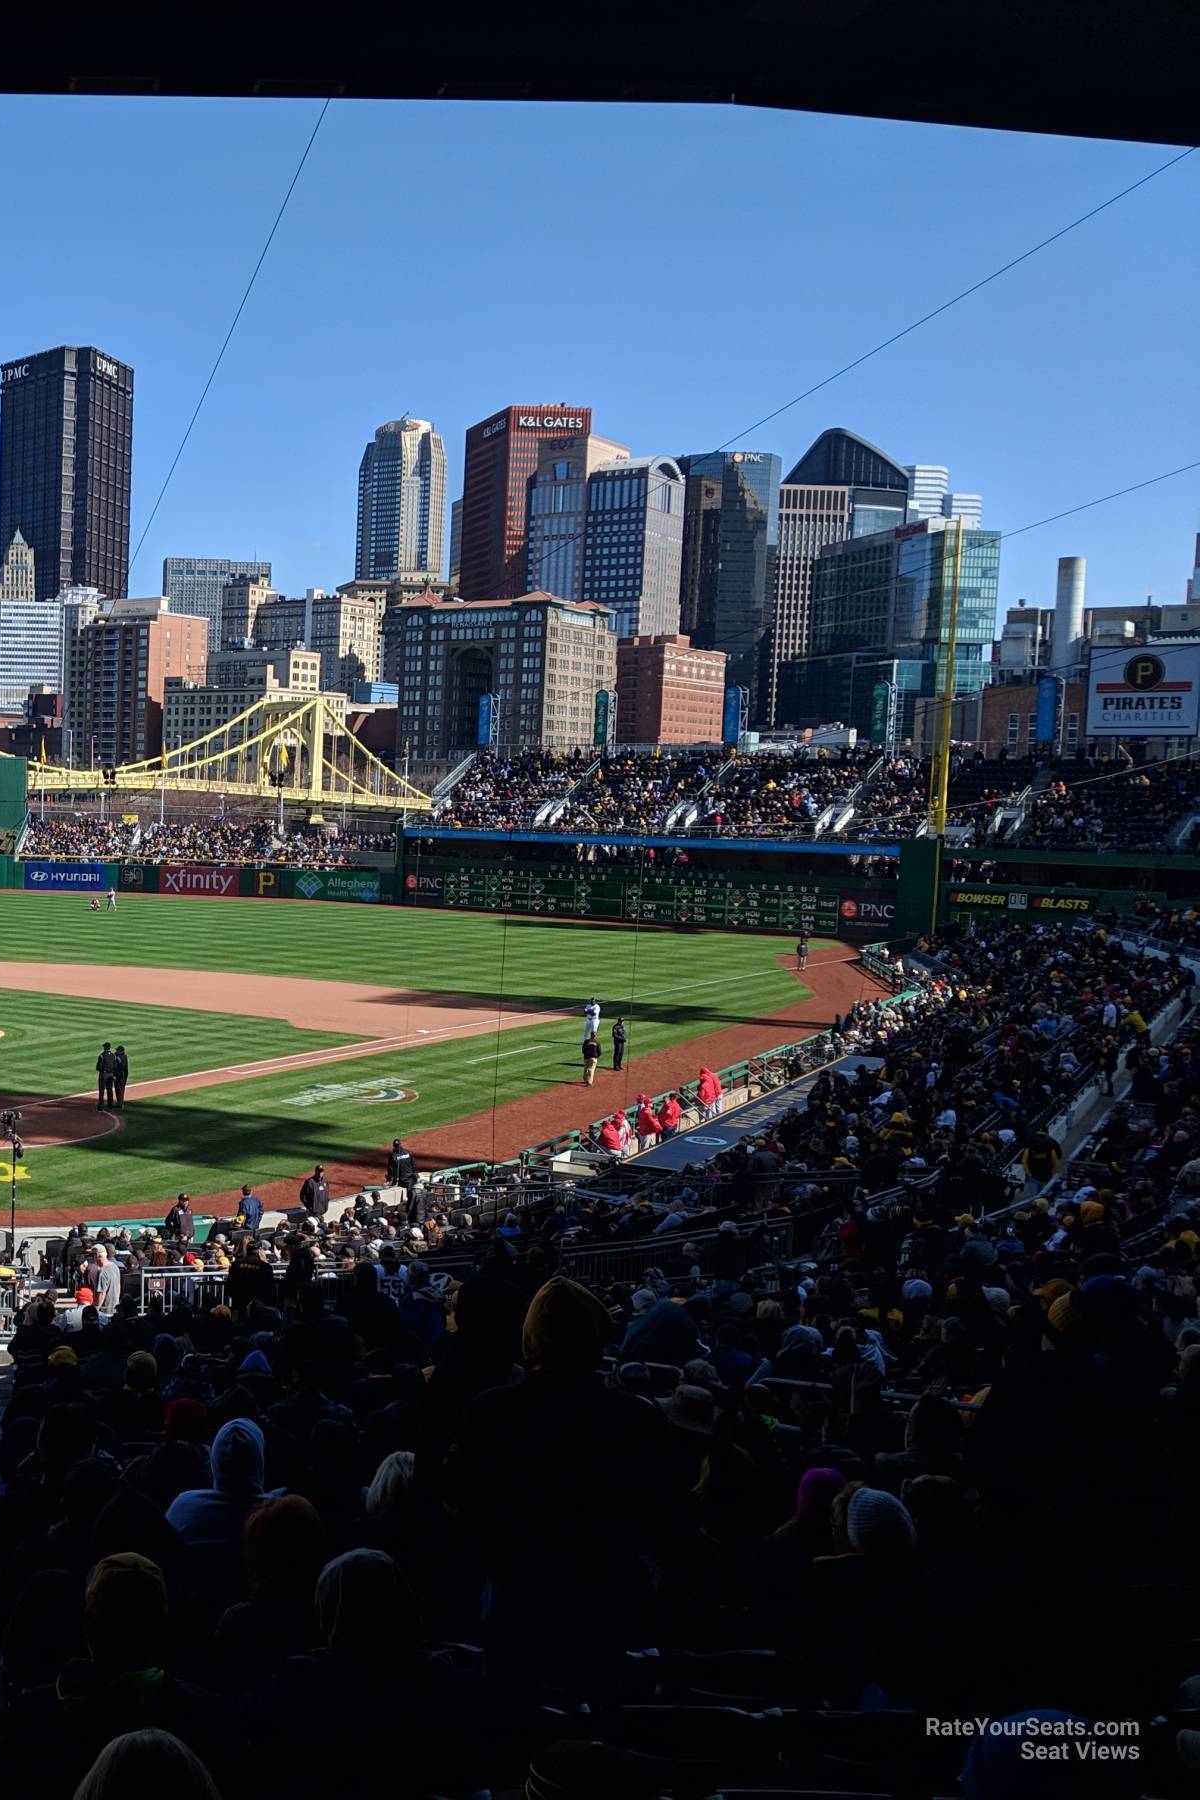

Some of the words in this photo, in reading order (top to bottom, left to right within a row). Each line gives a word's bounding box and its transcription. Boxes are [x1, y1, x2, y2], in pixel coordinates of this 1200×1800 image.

[0, 364, 30, 382] UPMC
[96, 356, 118, 379] UPMC
[519, 416, 542, 427] K&L
[544, 416, 583, 429] GATES
[744, 454, 764, 462] PNC
[1136, 662, 1154, 685] P
[1103, 696, 1183, 711] PIRATES
[1102, 711, 1182, 722] CHARITIES
[51, 872, 100, 882] HYUNDAI
[165, 868, 234, 894] xfinity
[257, 871, 275, 895] P
[327, 877, 379, 889] Allegheny
[418, 877, 443, 889] PNC
[956, 893, 1006, 905] BOWSER
[1040, 898, 1090, 910] BLASTS
[859, 903, 896, 918] PNC
